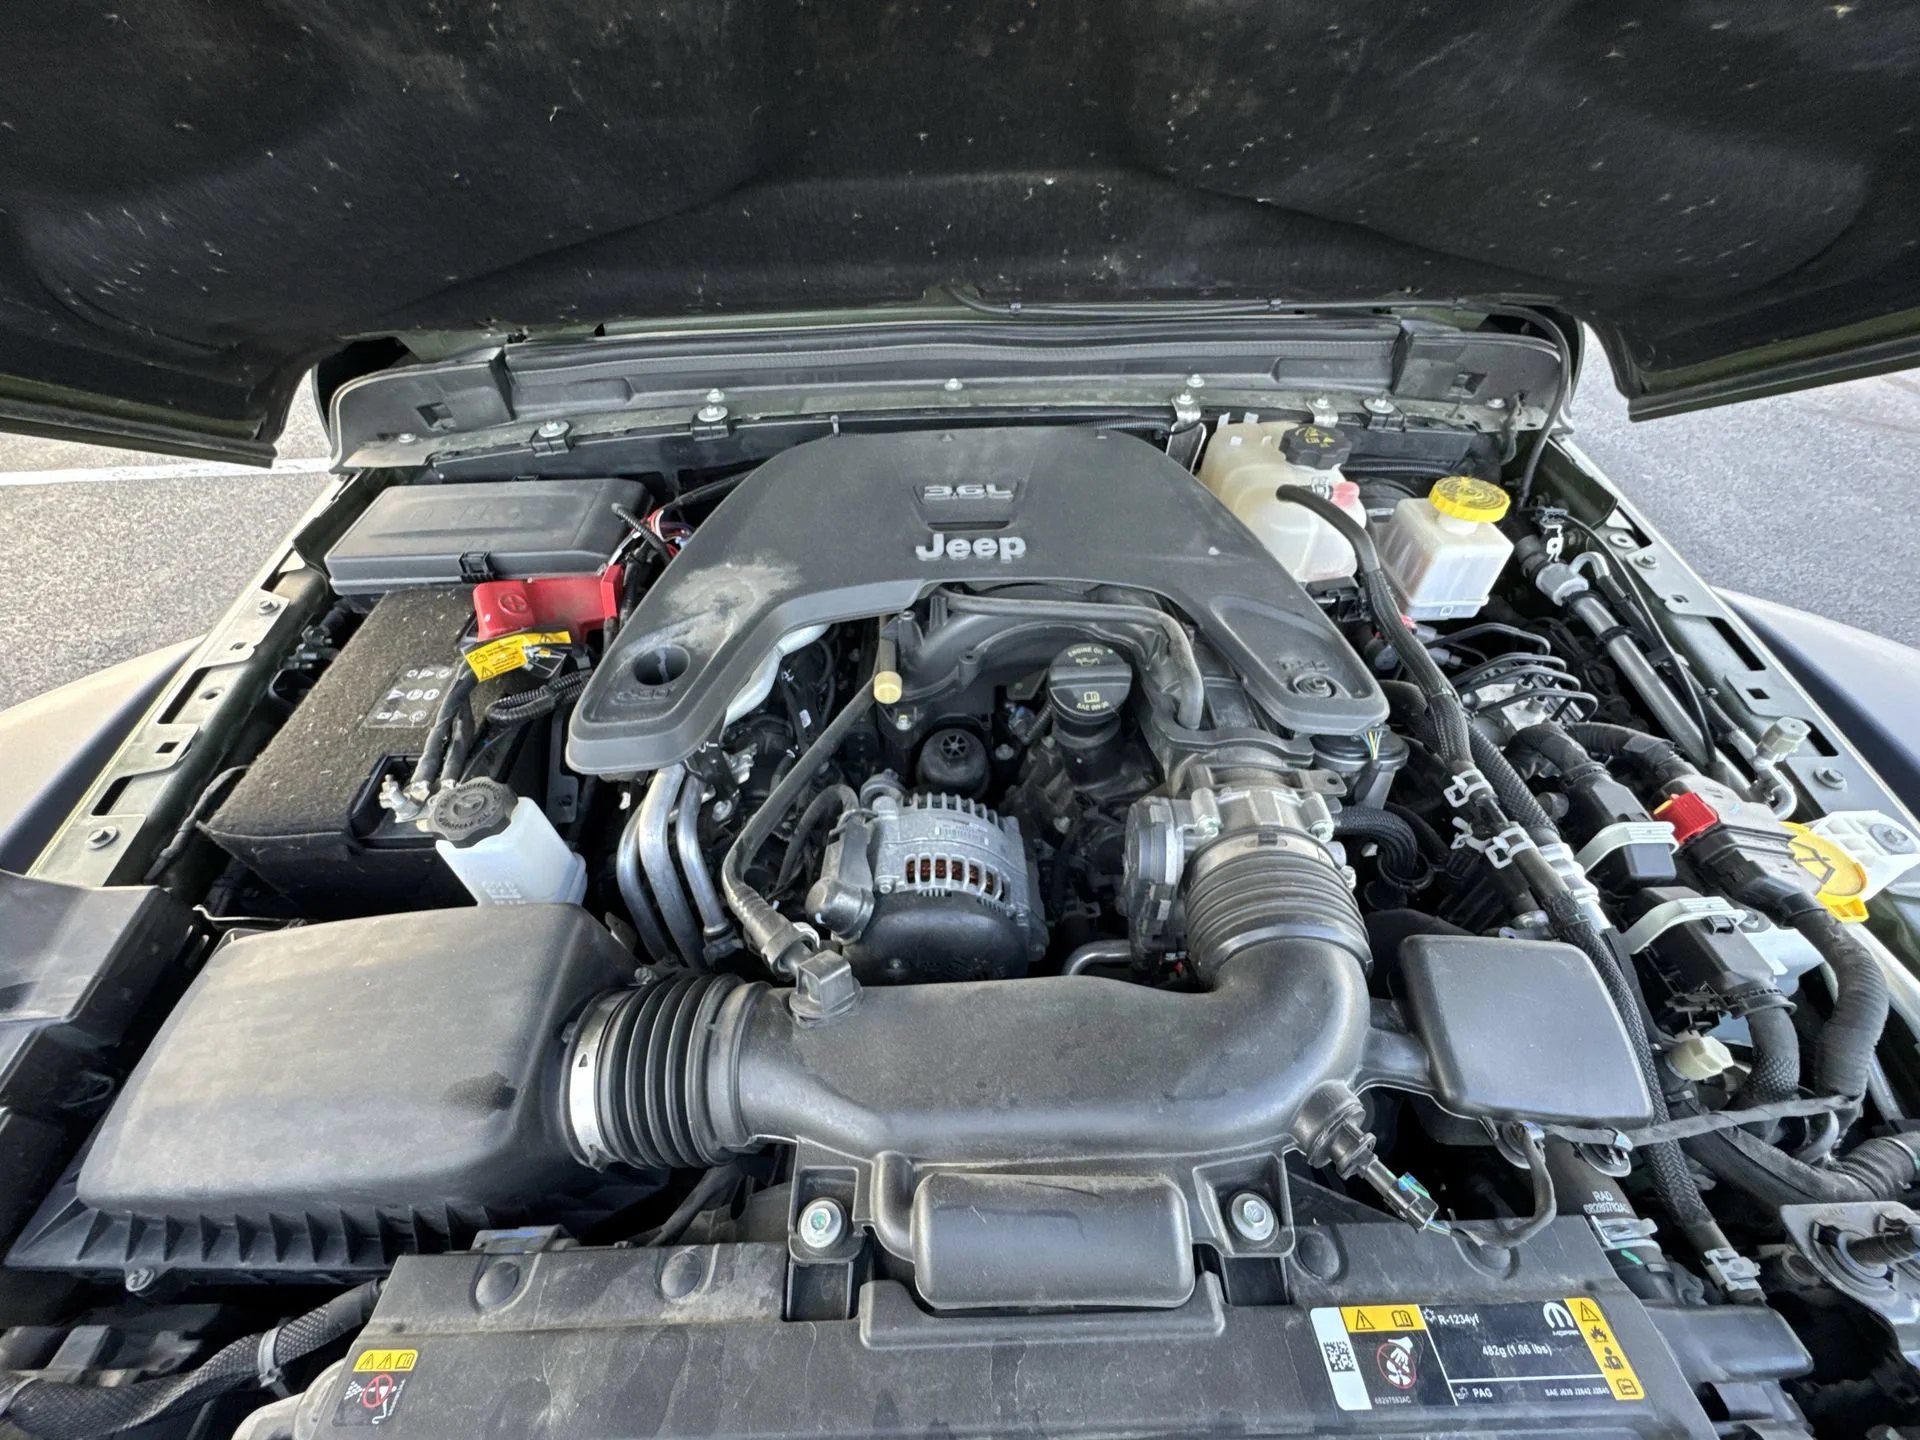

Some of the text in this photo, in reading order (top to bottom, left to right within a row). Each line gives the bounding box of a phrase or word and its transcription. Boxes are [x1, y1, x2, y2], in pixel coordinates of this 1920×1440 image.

[924, 484, 1014, 501] 3.6L
[915, 532, 1027, 564] Jeep
[1067, 646, 1104, 658] ENGINE OIL
[1076, 702, 1091, 712] SAE
[1592, 1190, 1614, 1202] RAD
[1437, 1313, 1480, 1326] R-1234yf
[1482, 1343, 1553, 1358] 482g (1.06 lbs)
[1472, 1387, 1494, 1399] PAG
